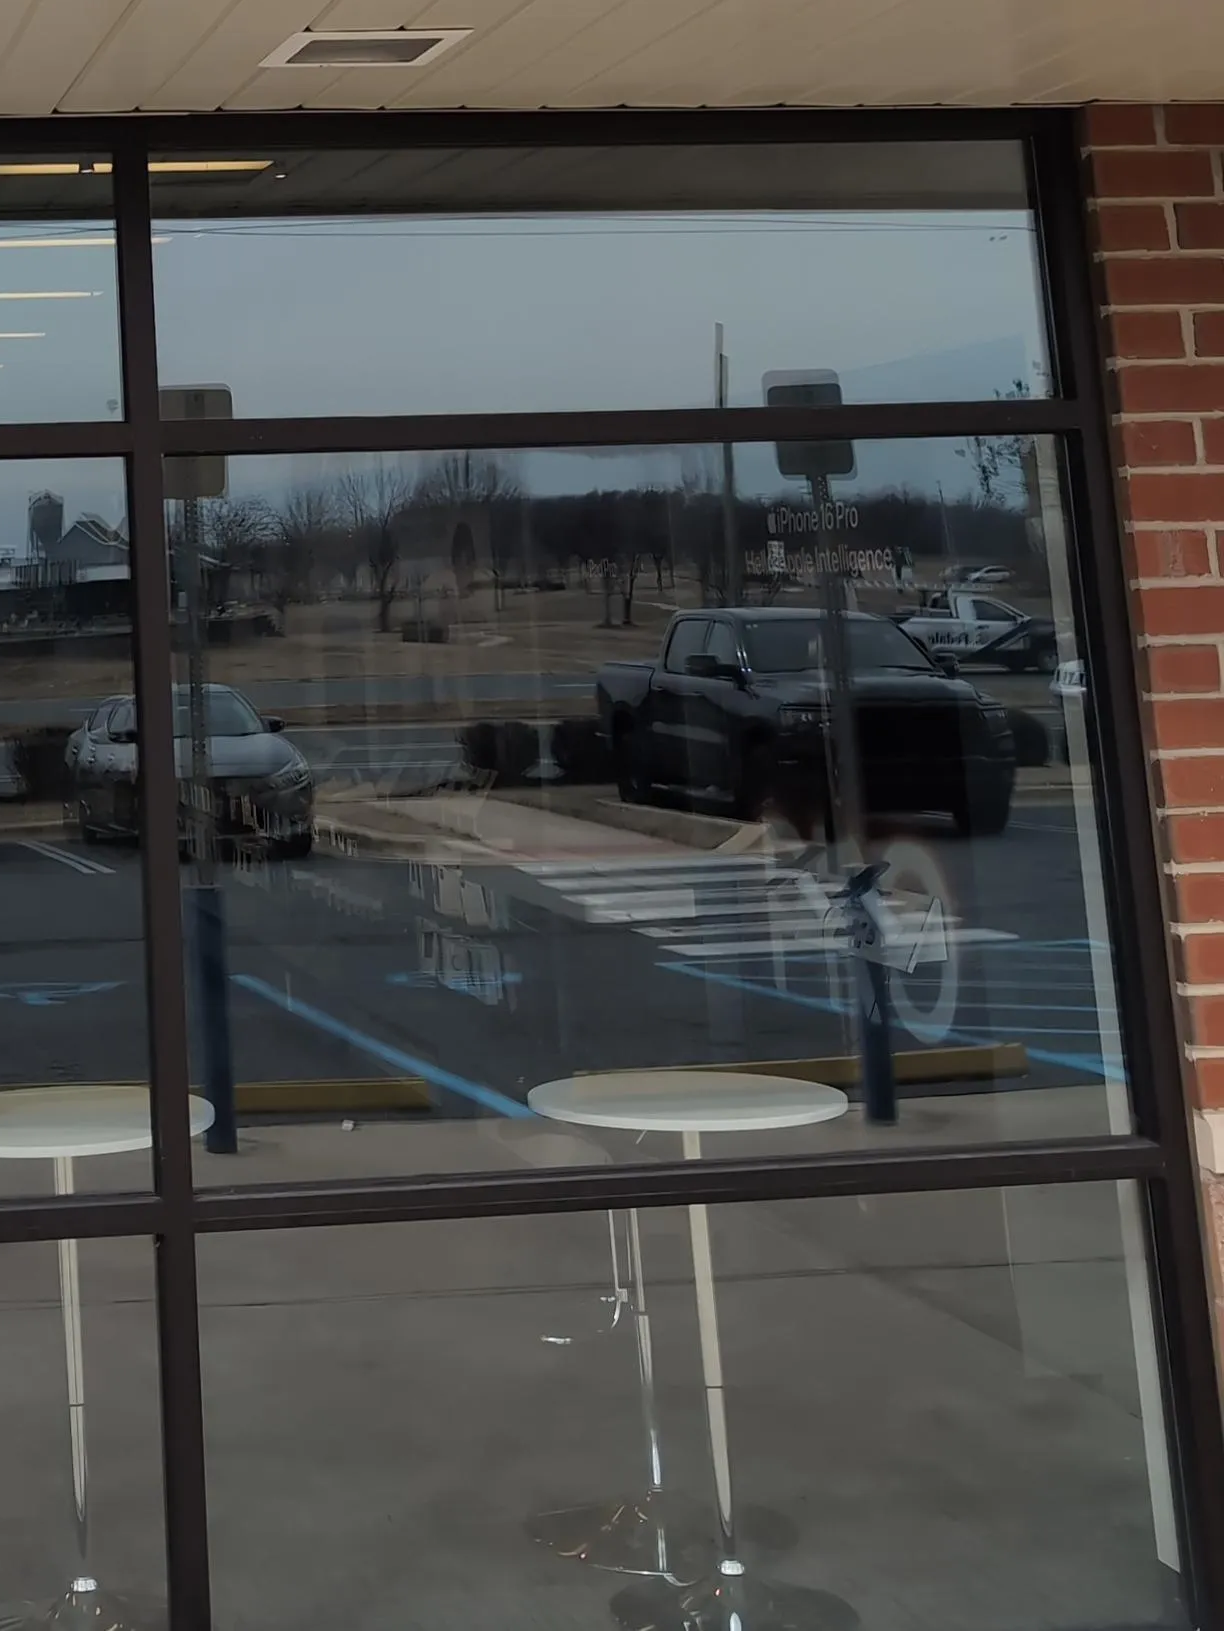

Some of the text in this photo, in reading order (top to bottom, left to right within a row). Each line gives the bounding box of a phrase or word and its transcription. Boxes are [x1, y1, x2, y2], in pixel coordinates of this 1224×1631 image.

[777, 501, 859, 533] iPhone 16 Pro
